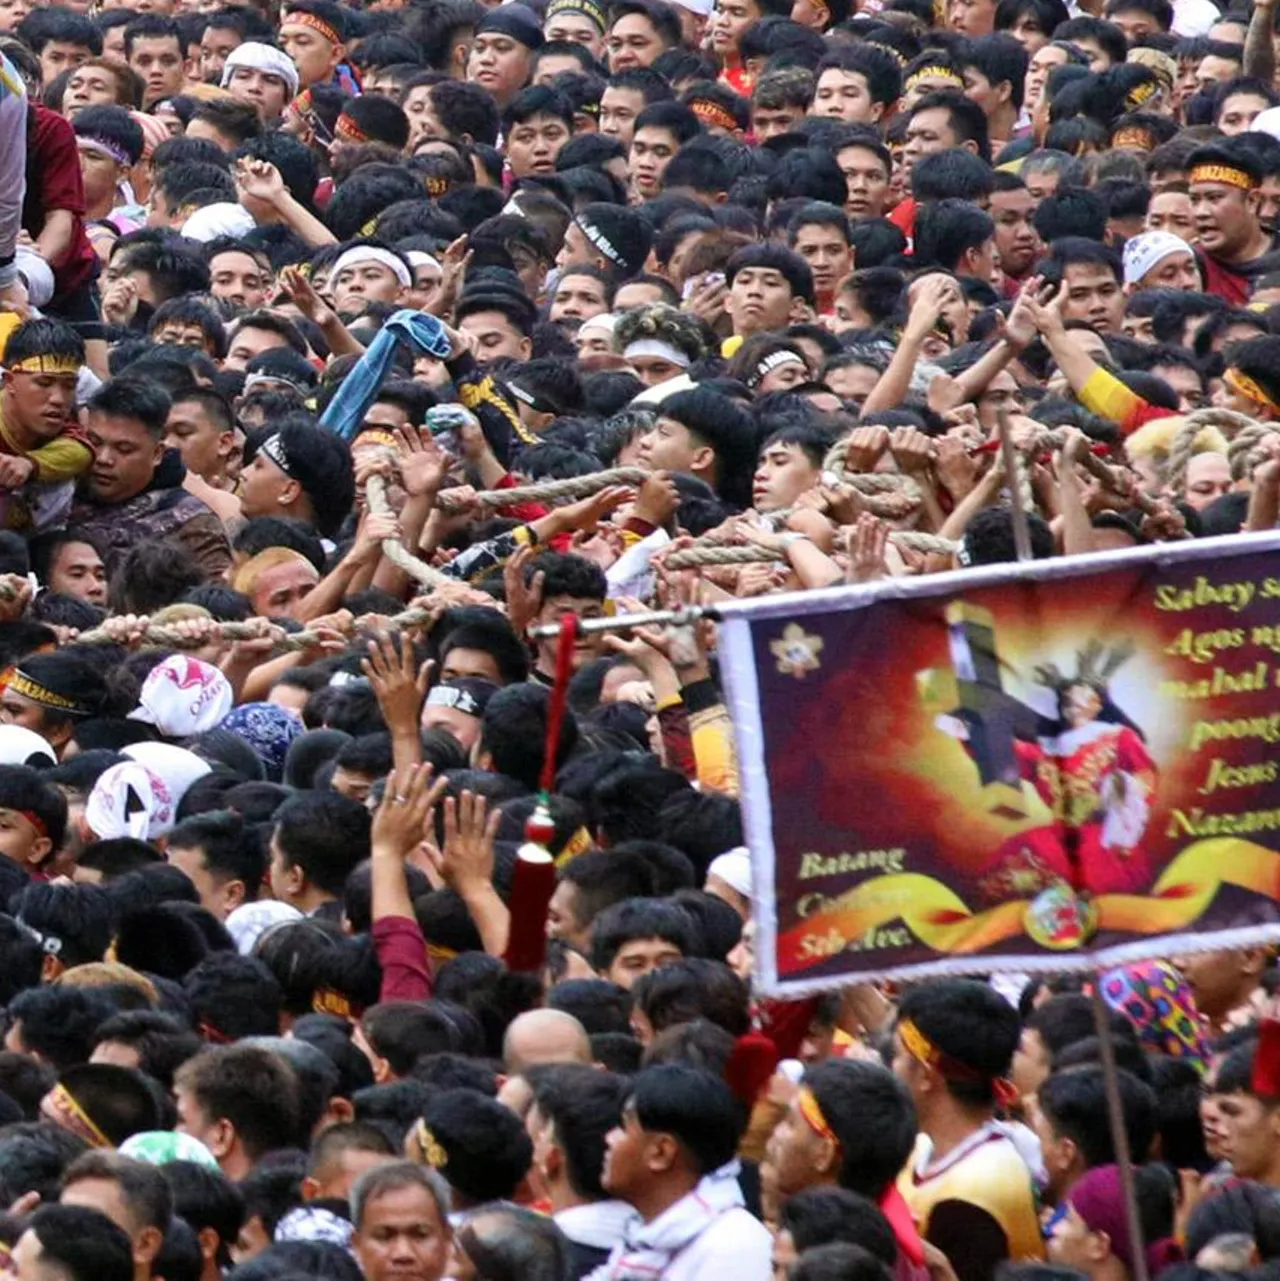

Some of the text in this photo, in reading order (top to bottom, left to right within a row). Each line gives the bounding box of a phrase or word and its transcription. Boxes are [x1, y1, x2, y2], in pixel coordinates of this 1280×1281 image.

[1154, 576, 1256, 612] Sabay
[1159, 661, 1268, 698] mahal
[1198, 756, 1279, 795] Jesus
[798, 848, 906, 879] Batang
